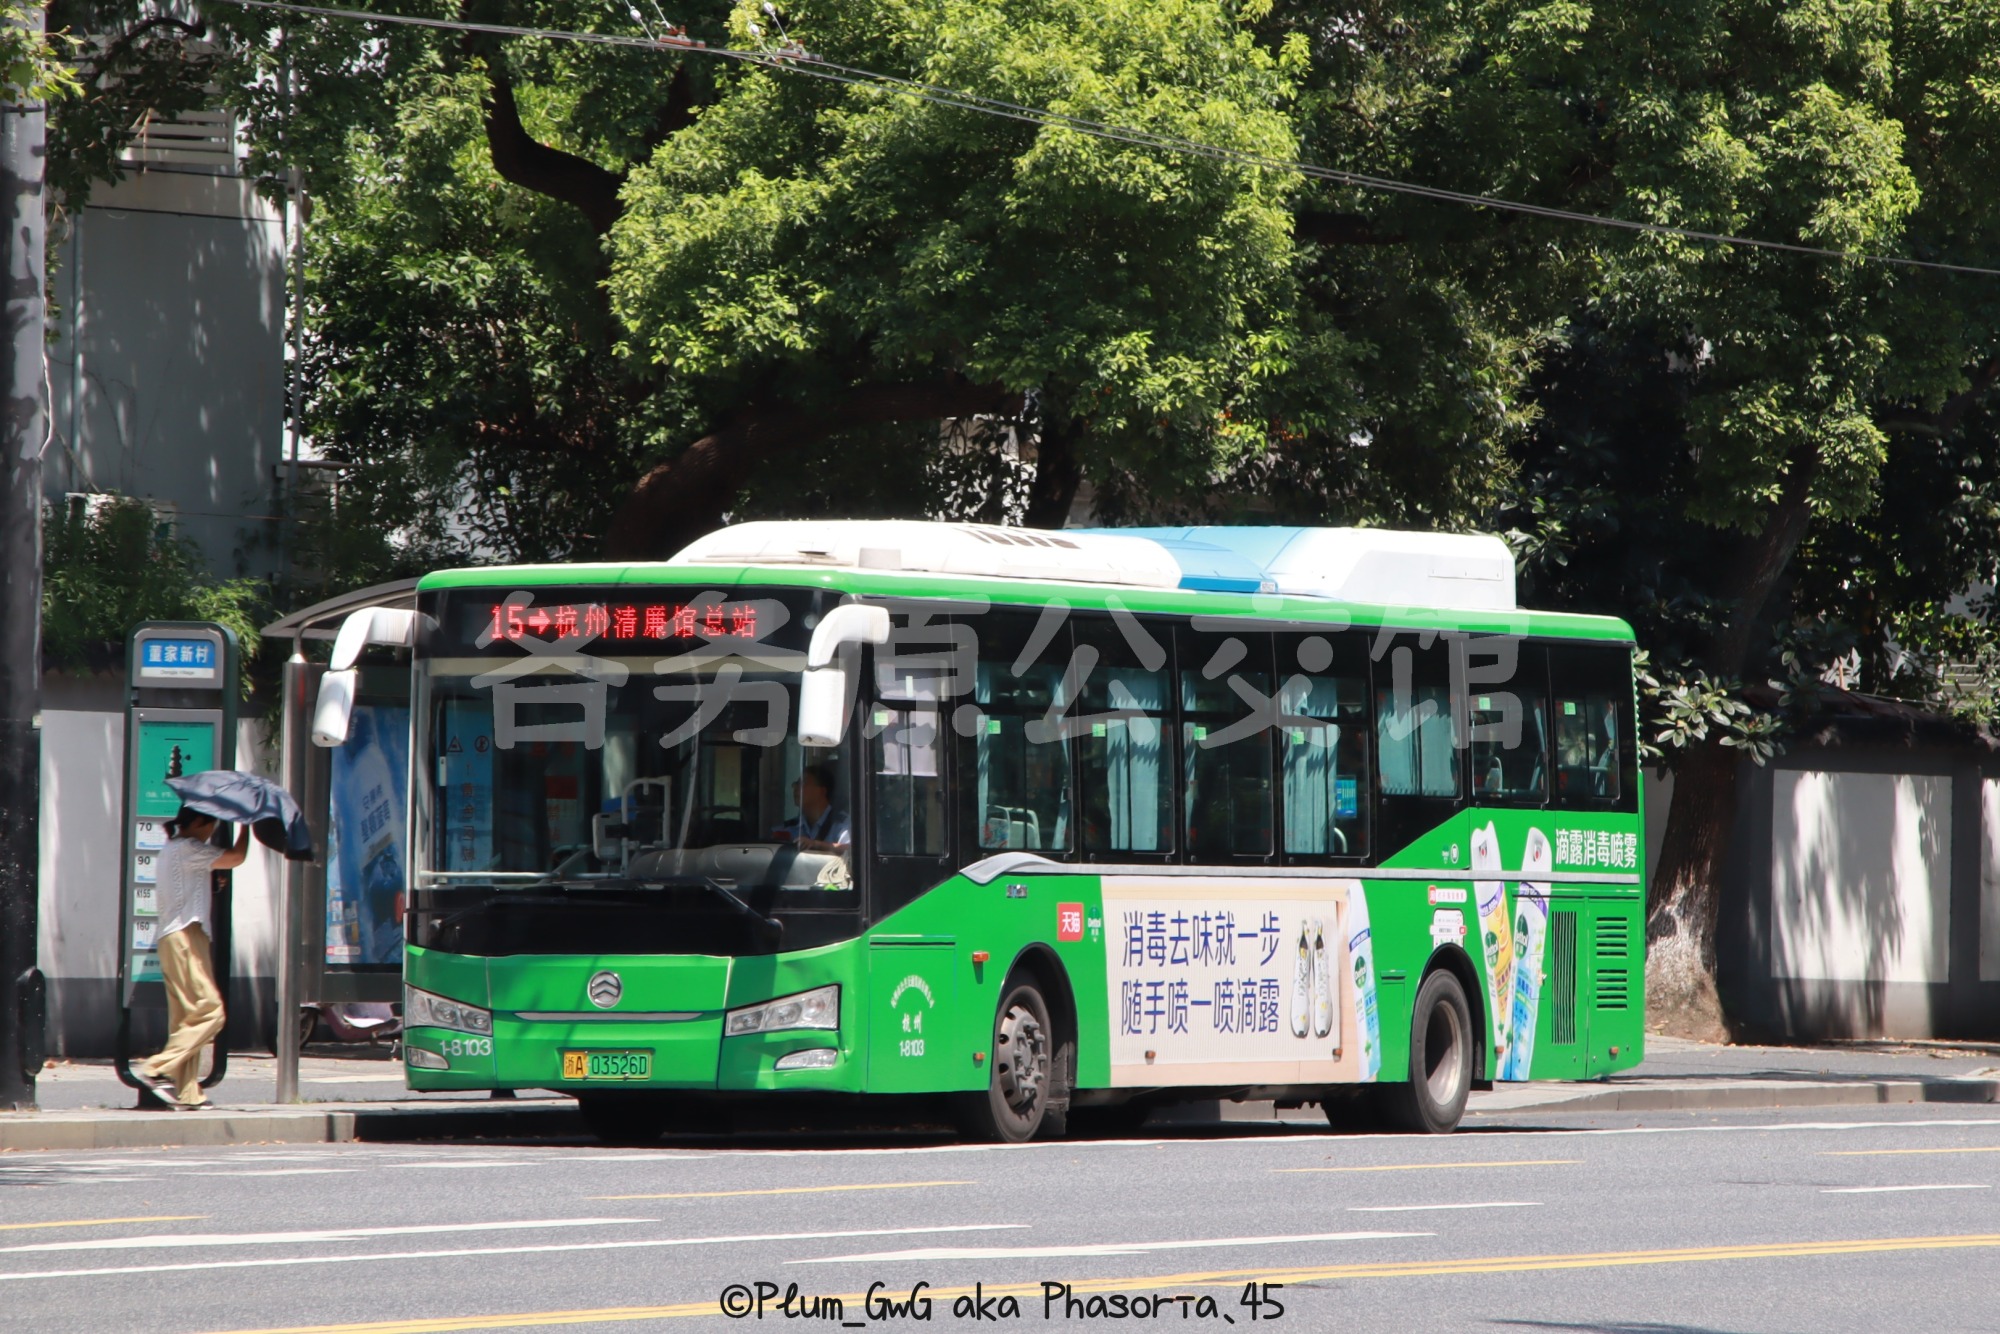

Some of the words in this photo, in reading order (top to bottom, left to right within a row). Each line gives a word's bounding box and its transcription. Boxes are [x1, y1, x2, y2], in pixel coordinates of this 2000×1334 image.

[491, 604, 524, 639] 15
[555, 604, 757, 639] 杭州清廉馆总站
[149, 645, 209, 664] 董家新村
[139, 822, 152, 832] 70
[1555, 828, 1638, 868] 滴露消毒喷雾
[137, 856, 151, 865] 90
[136, 922, 150, 931] 160
[1062, 911, 1081, 933] 天猫
[1122, 910, 1281, 968] 消毒去味就一步
[1121, 978, 1281, 1036] 随手喷一喷滴露
[440, 1039, 491, 1057] 1-8103
[899, 1039, 925, 1057] 1-8103
